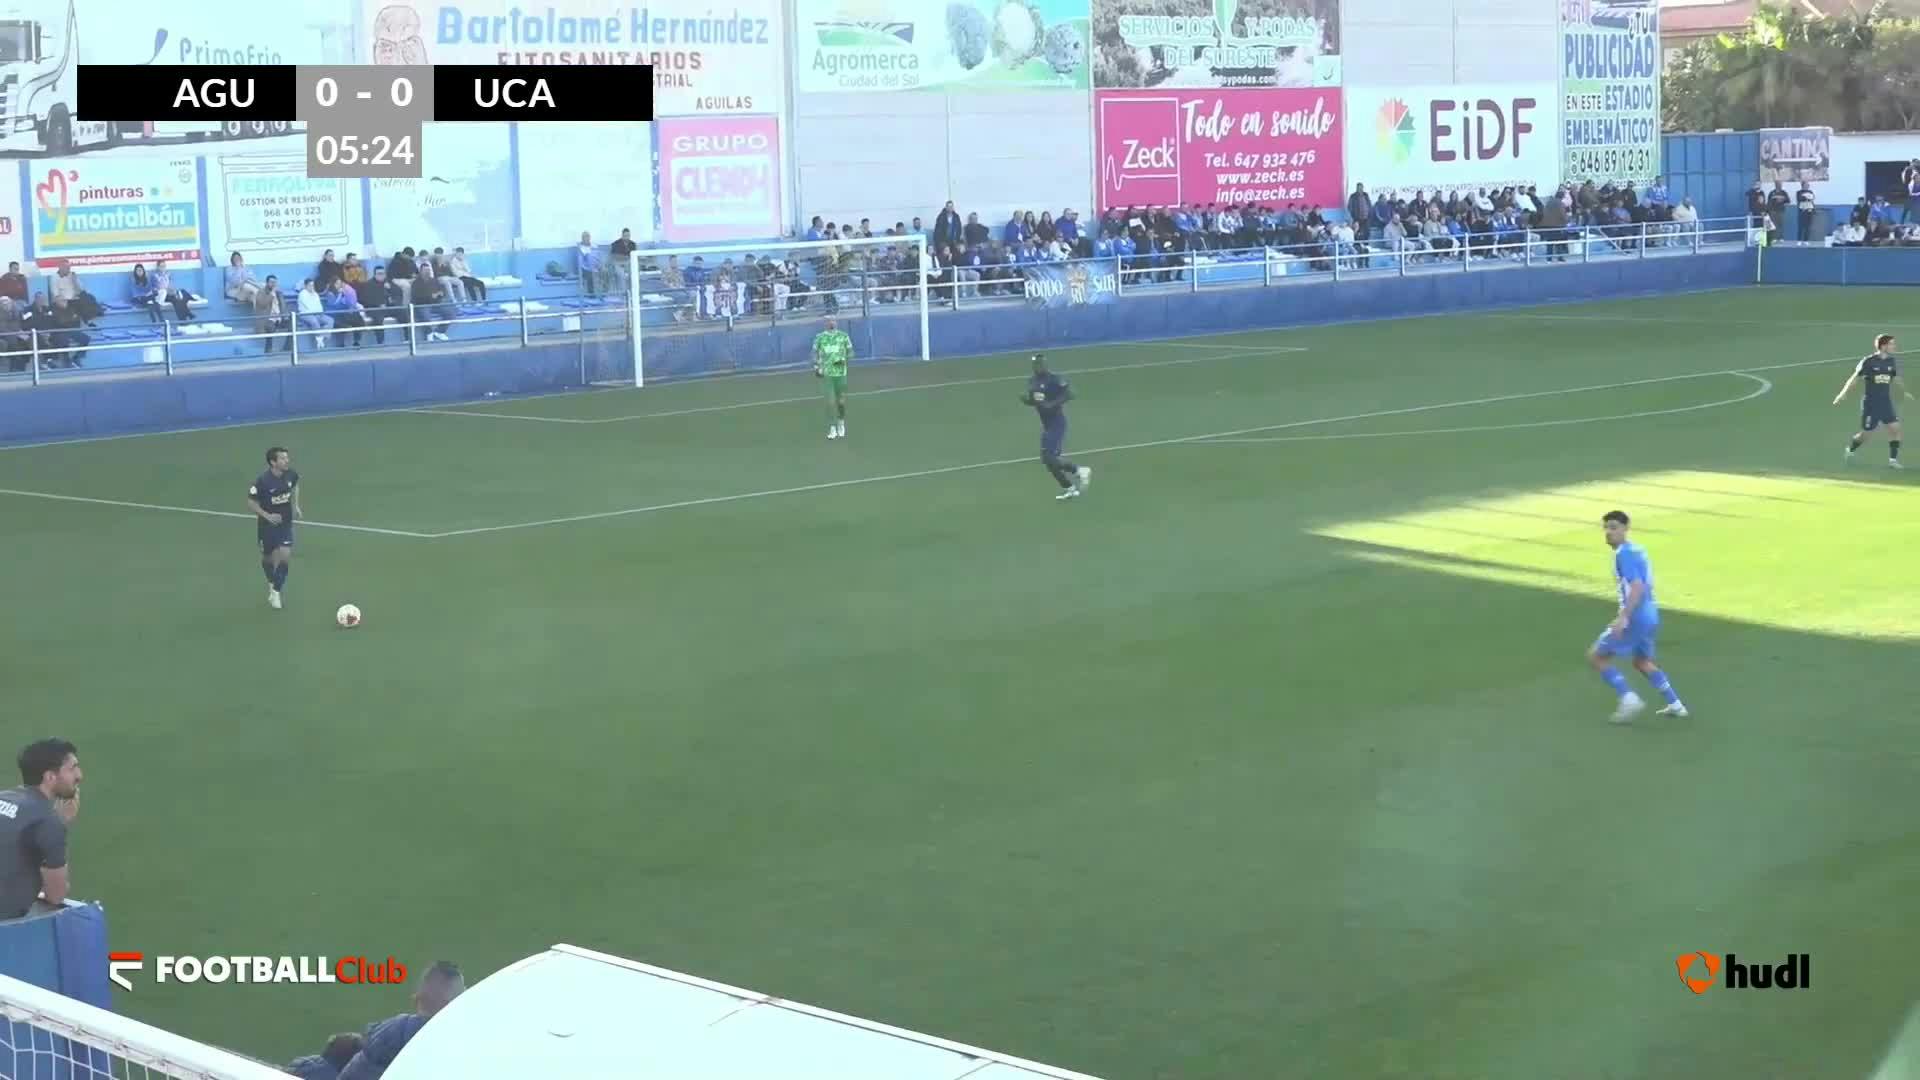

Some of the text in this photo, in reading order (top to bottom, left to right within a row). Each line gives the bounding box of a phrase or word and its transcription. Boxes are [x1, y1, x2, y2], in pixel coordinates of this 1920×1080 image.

[437, 6, 769, 45] Bartolomé Hernández
[1119, 16, 1215, 37] SERVICIOS
[812, 49, 920, 75] Agromerca
[1164, 47, 1279, 68] DEL SURESTE
[1564, 33, 1655, 79] PUBLICIDAD
[838, 73, 920, 87] Ciudad del Sol
[696, 96, 753, 110] AGUILAS
[1566, 84, 1653, 111] EN ESTE ESTADIO
[1181, 96, 1336, 143] Todo en sonido
[1430, 97, 1537, 162] EiDF
[1565, 112, 1655, 145] EMBLEMÁTICO?
[672, 133, 769, 153] GRUPO
[1122, 137, 1175, 169] Zeck
[1760, 136, 1829, 160] CANTINA
[1204, 150, 1316, 168] Tel. 647 932 476
[1580, 149, 1650, 173] 646 89 12 31
[1216, 168, 1305, 186] www.zeck.es
[79, 186, 145, 203] pinturas
[1216, 187, 1305, 204] info@zeck.es
[67, 204, 186, 231] montalbán
[284, 207, 301, 217] 410
[304, 206, 321, 216] 323
[264, 219, 322, 231] 679 475 313
[1024, 279, 1064, 299] FONDO
